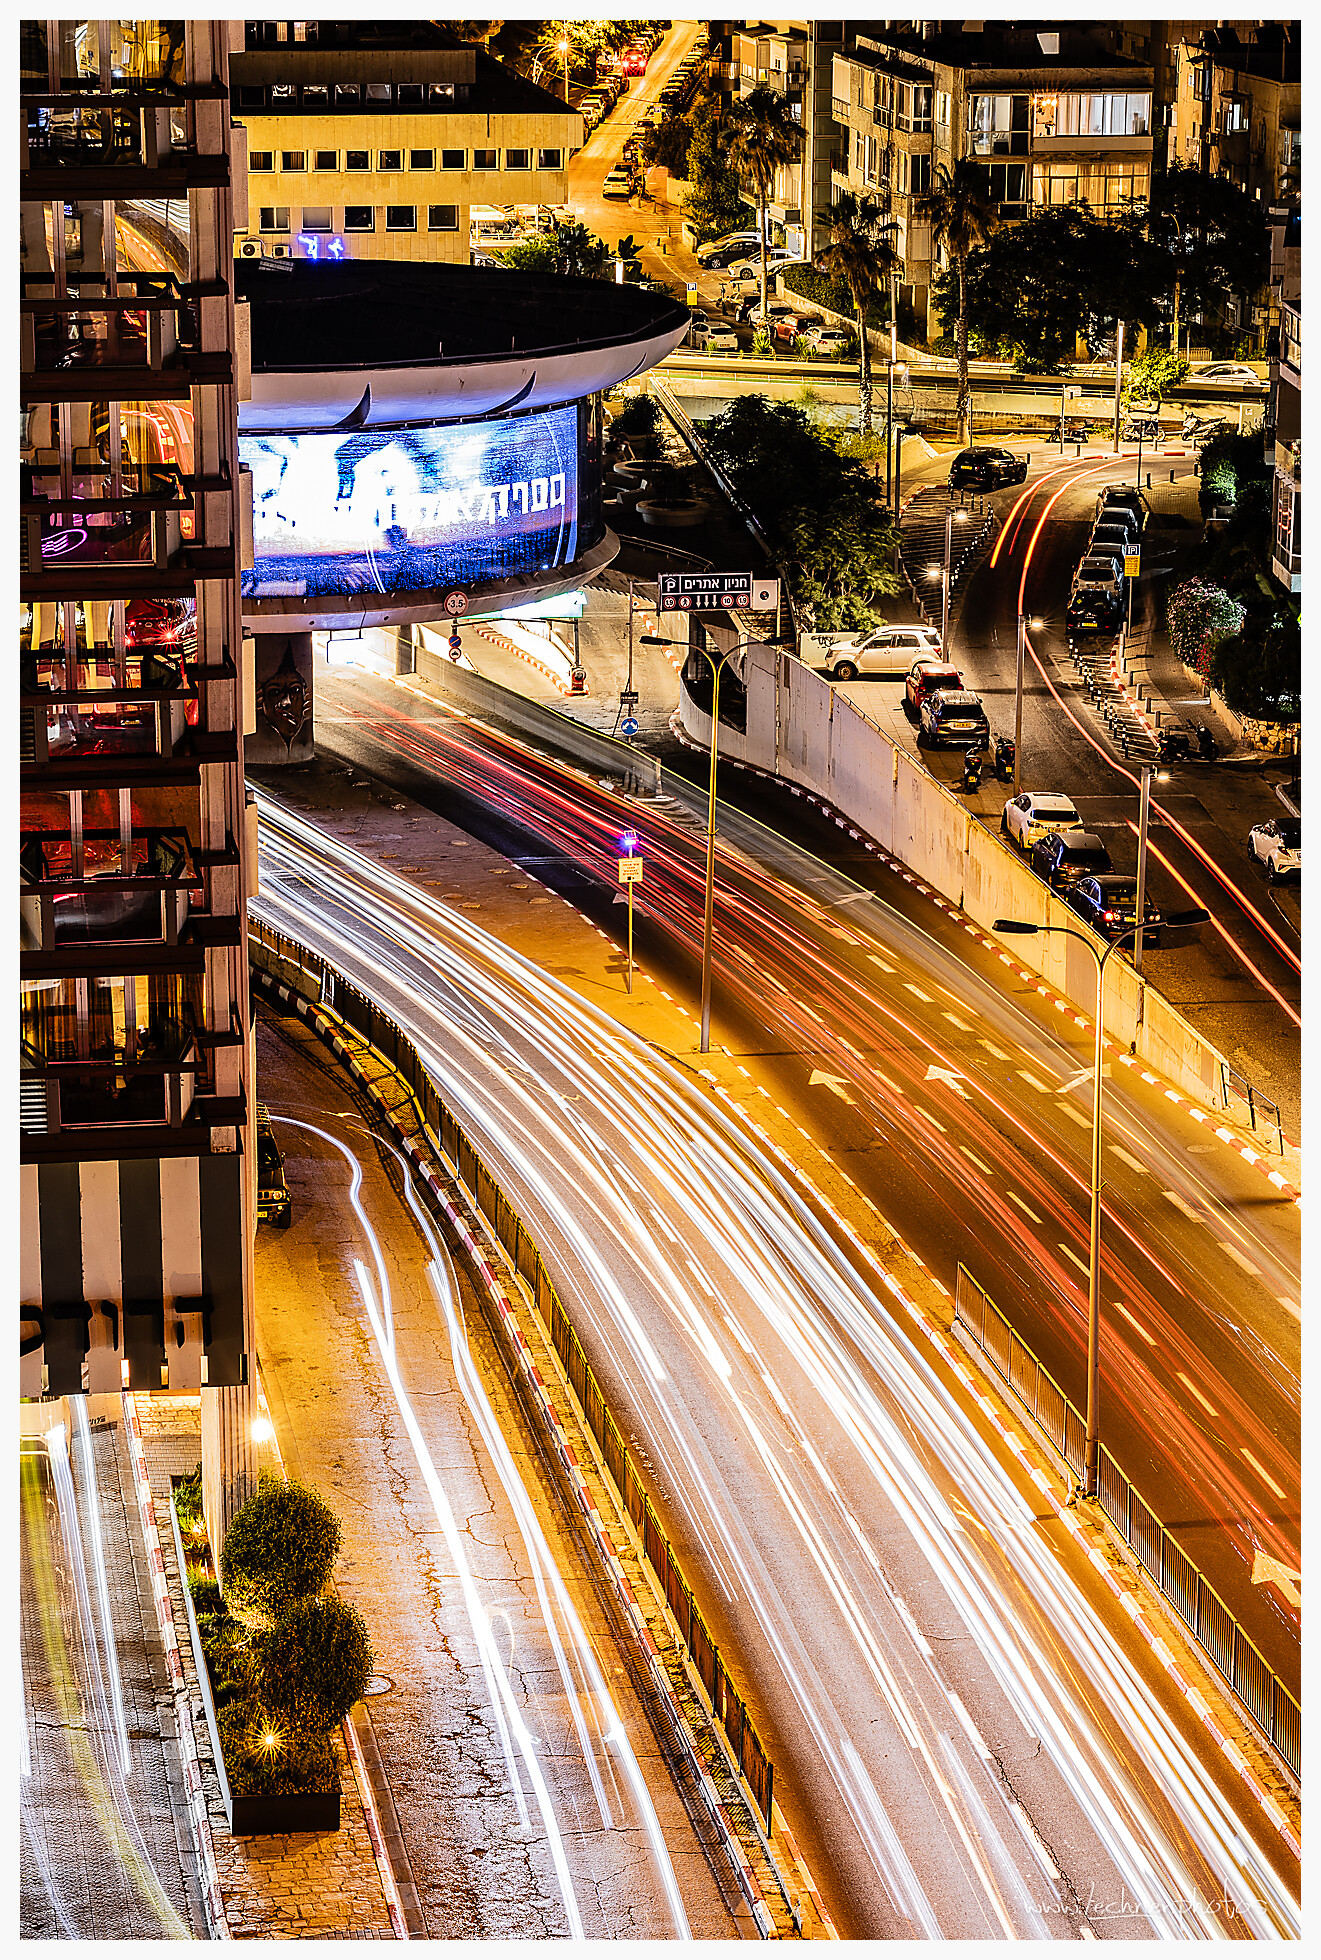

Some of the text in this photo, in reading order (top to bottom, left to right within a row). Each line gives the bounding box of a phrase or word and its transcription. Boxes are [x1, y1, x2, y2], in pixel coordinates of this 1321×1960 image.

[684, 578, 748, 591] חניון אתרים
[450, 599, 464, 608] 3.5
